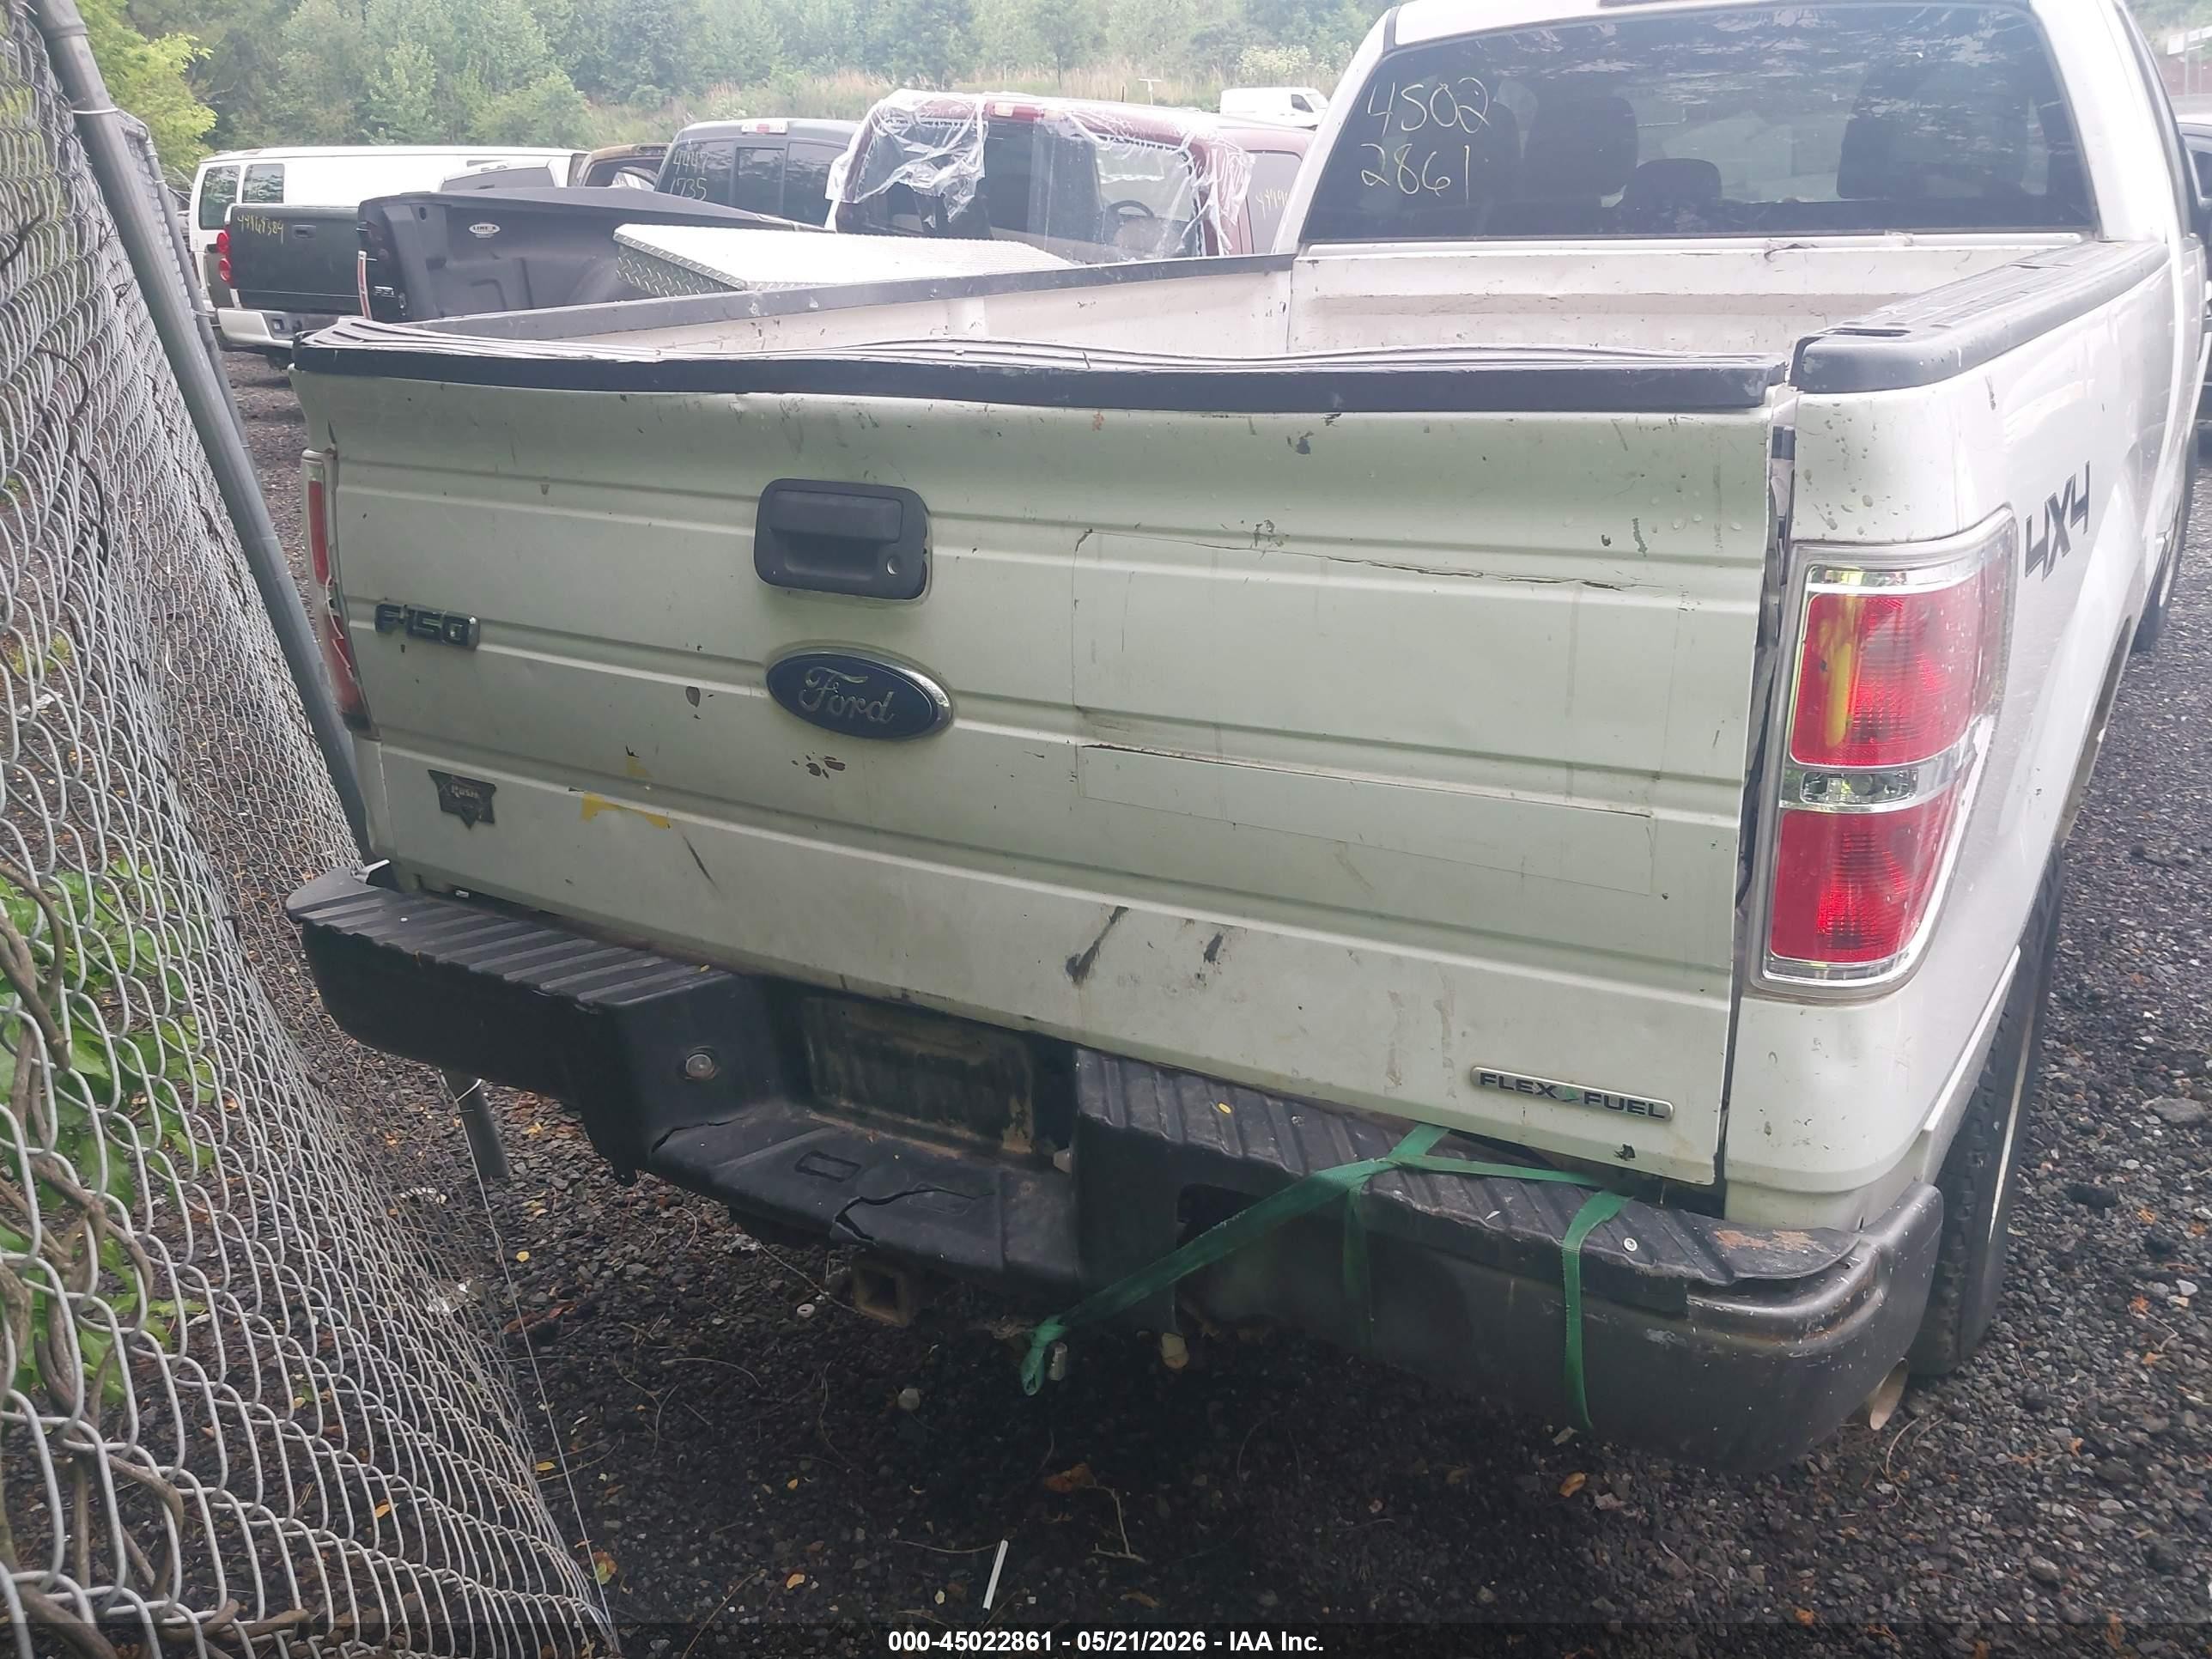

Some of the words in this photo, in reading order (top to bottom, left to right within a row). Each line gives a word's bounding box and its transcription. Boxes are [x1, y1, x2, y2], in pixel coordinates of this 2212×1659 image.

[1366, 76, 1491, 137] 4502
[670, 177, 708, 201] 1735
[1360, 143, 1470, 199] 2861
[2025, 460, 2090, 582] 4X4
[799, 666, 896, 724] Ford
[1480, 1072, 1559, 1099] FLEX
[1583, 1091, 1666, 1119] FUEL
